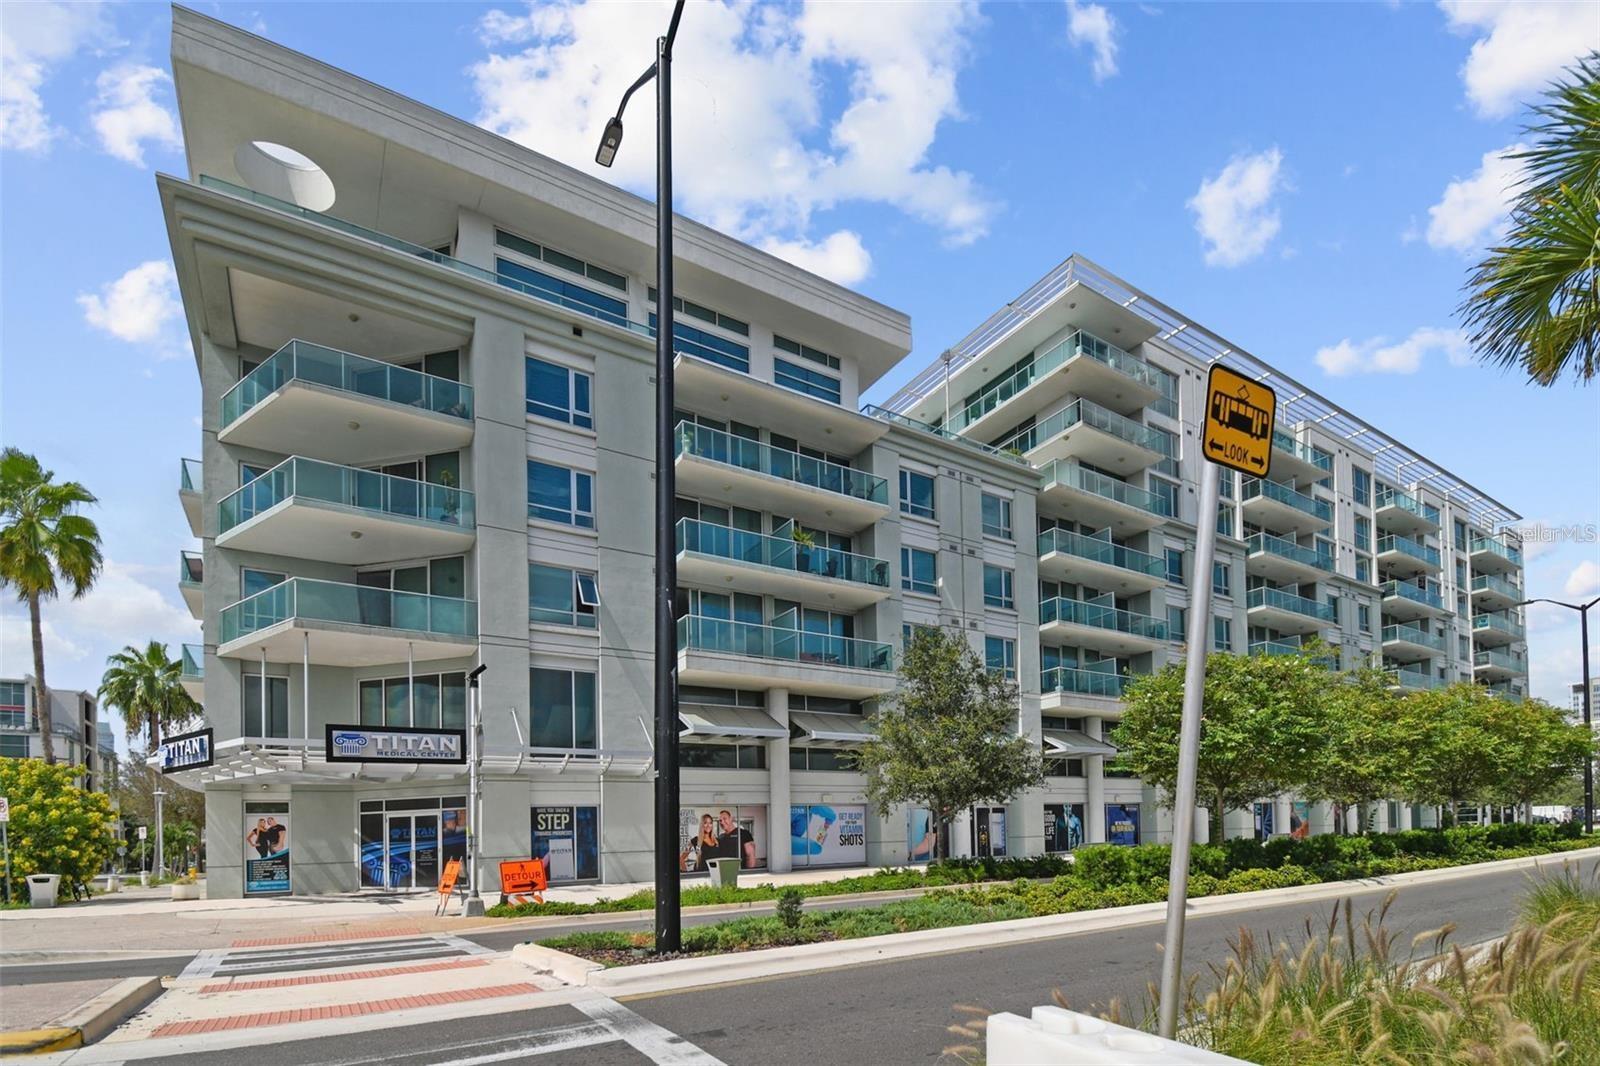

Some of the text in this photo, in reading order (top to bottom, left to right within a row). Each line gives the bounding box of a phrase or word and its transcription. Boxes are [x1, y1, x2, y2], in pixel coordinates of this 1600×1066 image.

[1223, 441, 1249, 465] LOOK
[167, 737, 200, 759] TITAN
[371, 734, 457, 752] TITAN
[537, 813, 570, 830] STEP
[839, 833, 864, 846] SHOTS
[504, 871, 541, 881] DETOUR
